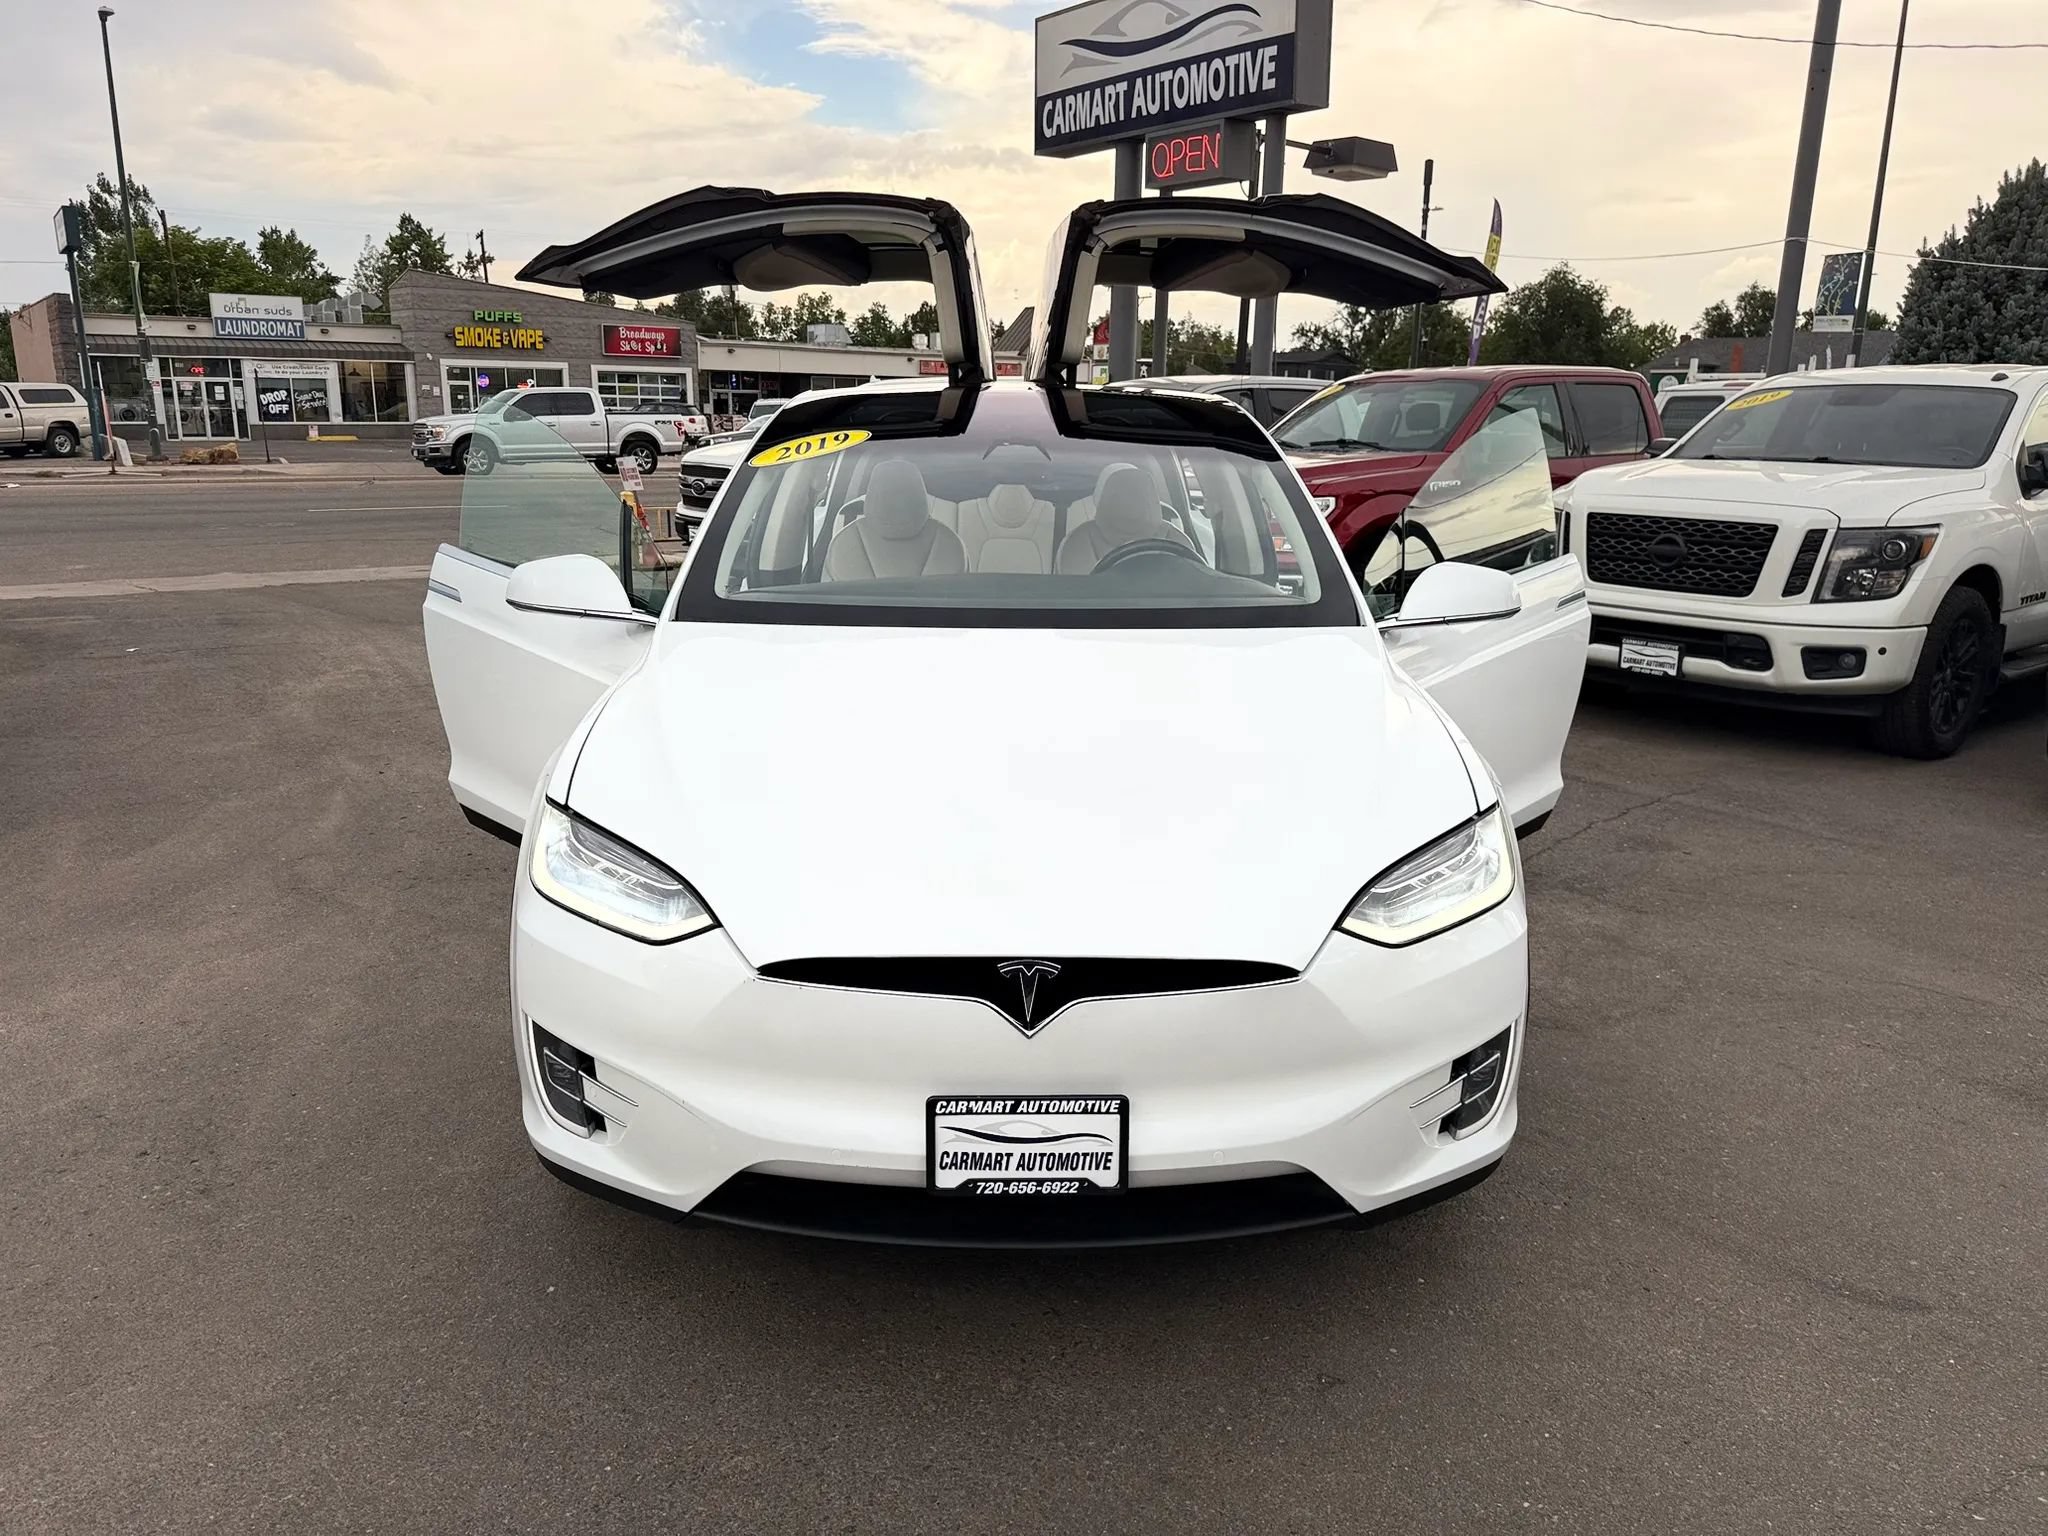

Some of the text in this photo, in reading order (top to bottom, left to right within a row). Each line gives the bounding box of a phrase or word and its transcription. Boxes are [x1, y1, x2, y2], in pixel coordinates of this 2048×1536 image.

[1042, 45, 1278, 138] CARMART AUTOMOTIVE
[1152, 133, 1221, 178] OPEN
[264, 307, 293, 316] suds
[474, 310, 522, 323] PUFFS
[217, 319, 302, 337] LAUNDROMAT
[619, 326, 665, 341] Broadways
[454, 326, 544, 349] SMOKE & VAPE
[259, 389, 288, 405] DROP
[268, 403, 289, 414] OFF
[775, 432, 850, 461] 2019
[2020, 591, 2047, 605] TITAN
[1623, 656, 1645, 665] CARMART
[935, 1100, 1120, 1114] CARMART AUTOMOTIVE
[938, 1150, 1114, 1172] CARMART AUTOMOTIVE
[975, 1180, 1080, 1195] 720-656-6922
